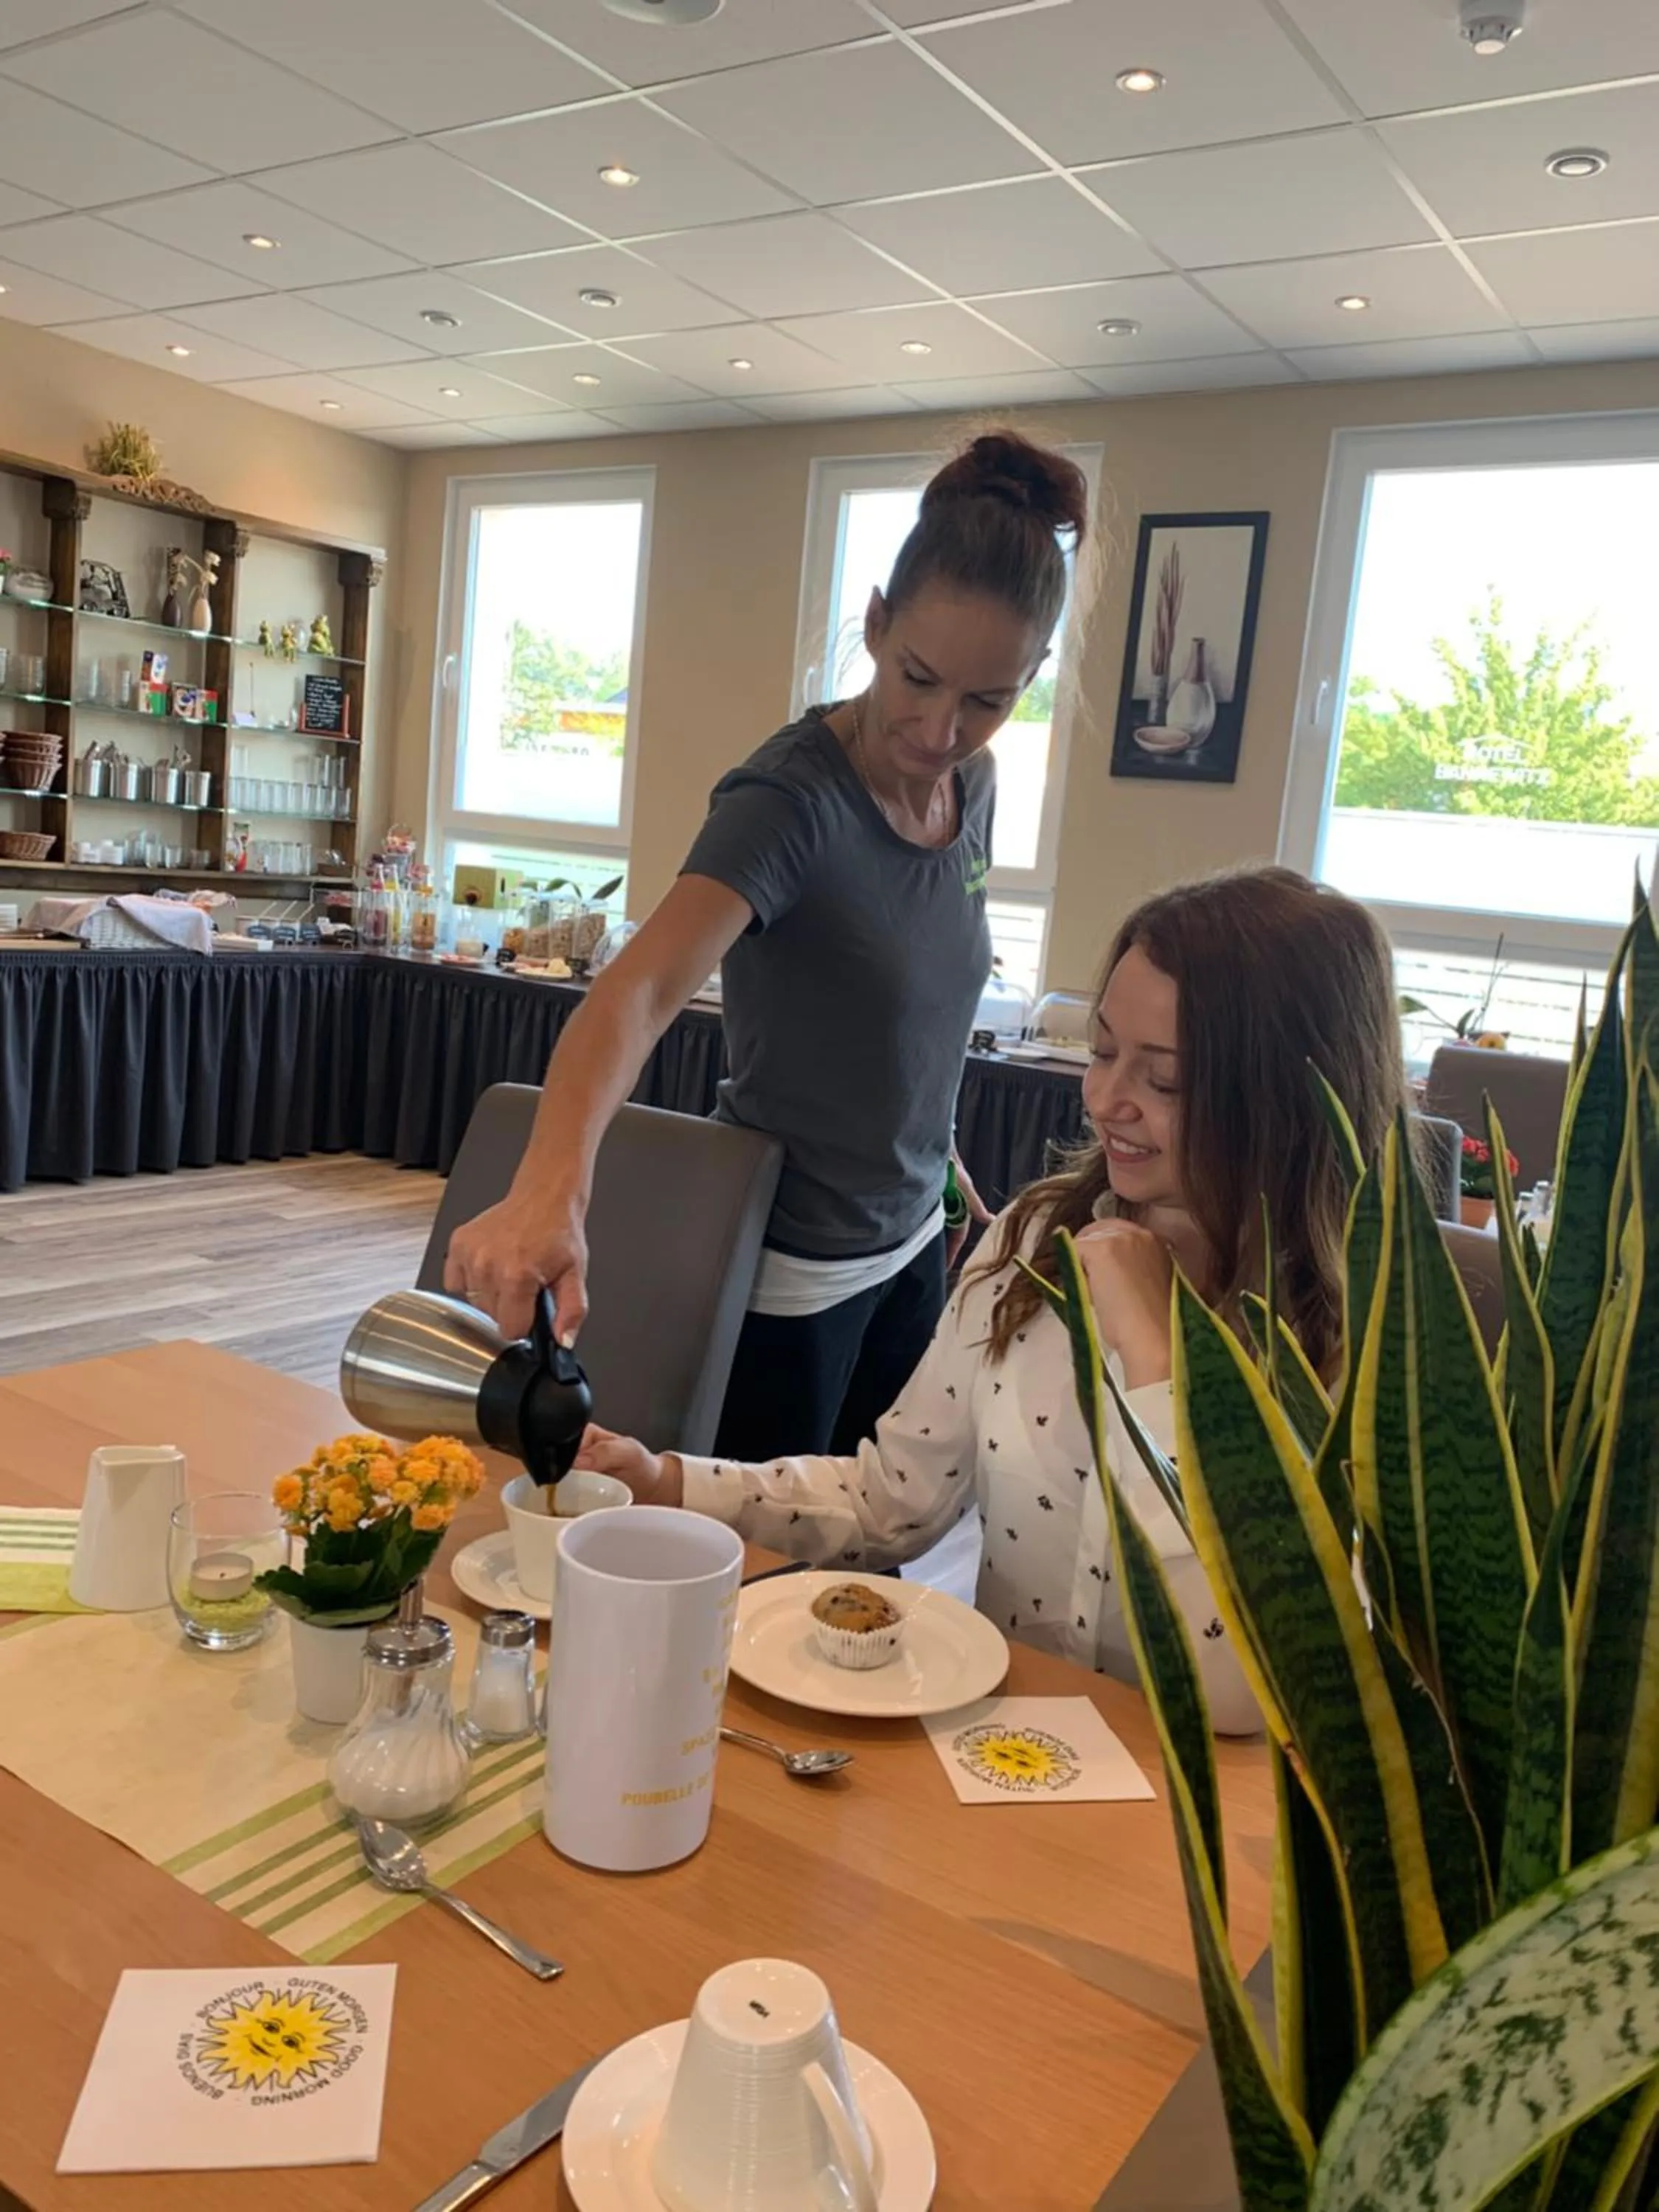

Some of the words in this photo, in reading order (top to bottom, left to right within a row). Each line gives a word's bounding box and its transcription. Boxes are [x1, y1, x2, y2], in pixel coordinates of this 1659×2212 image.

[195, 1981, 264, 2018] BONJOUR
[288, 1978, 337, 1995] GUTEN
[336, 1992, 368, 2034] MORGEN
[331, 2045, 364, 2079] GOOD
[178, 2062, 224, 2100] BUENOS
[251, 2079, 330, 2106] MORNING
